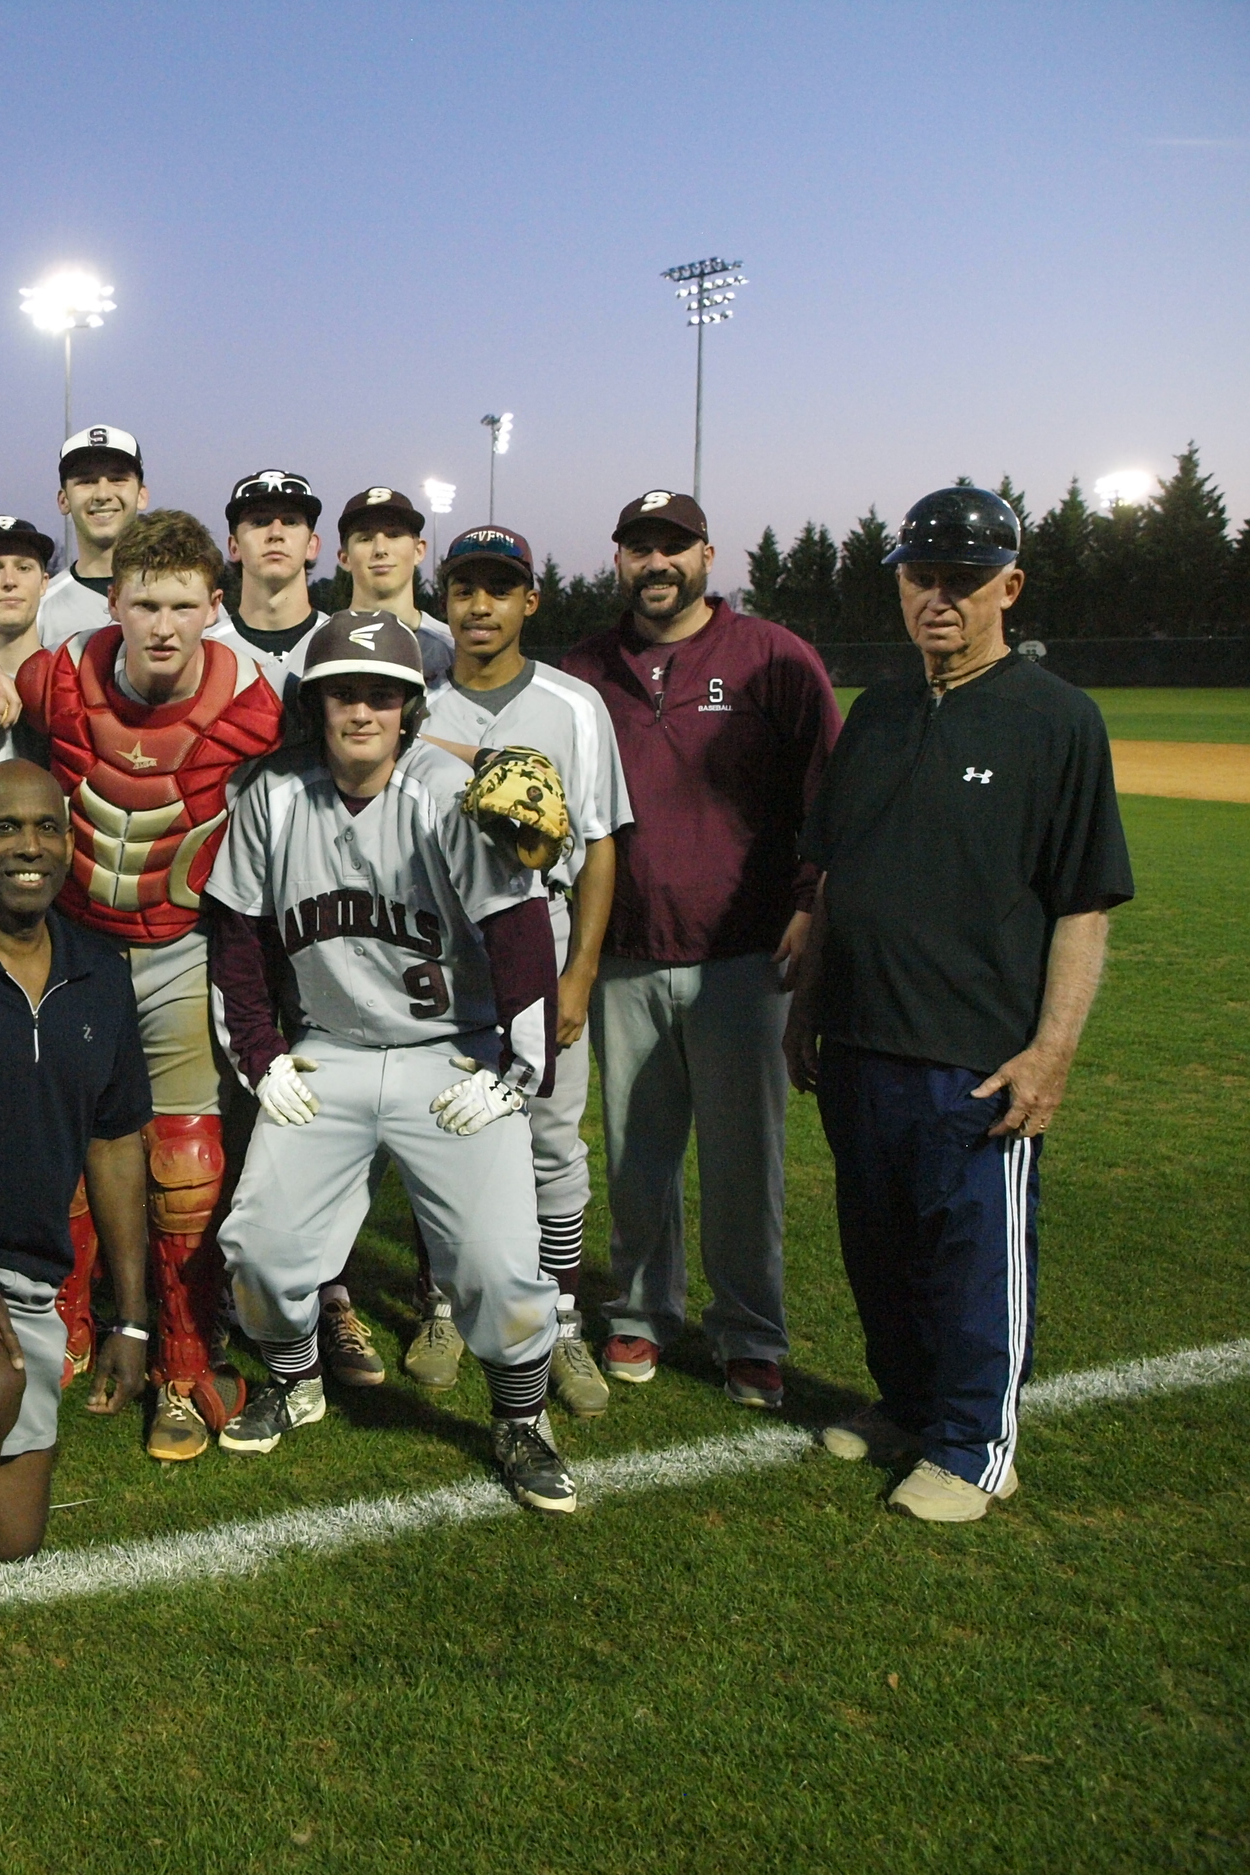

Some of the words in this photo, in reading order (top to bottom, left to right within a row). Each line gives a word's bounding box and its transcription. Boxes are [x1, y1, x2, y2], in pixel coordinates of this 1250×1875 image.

[89, 428, 108, 446] S
[366, 487, 393, 505] S
[640, 492, 672, 512] S
[709, 678, 724, 703] S
[697, 704, 734, 712] BASEBALL
[285, 887, 442, 959] ADMIRALS
[402, 959, 450, 1019] 9
